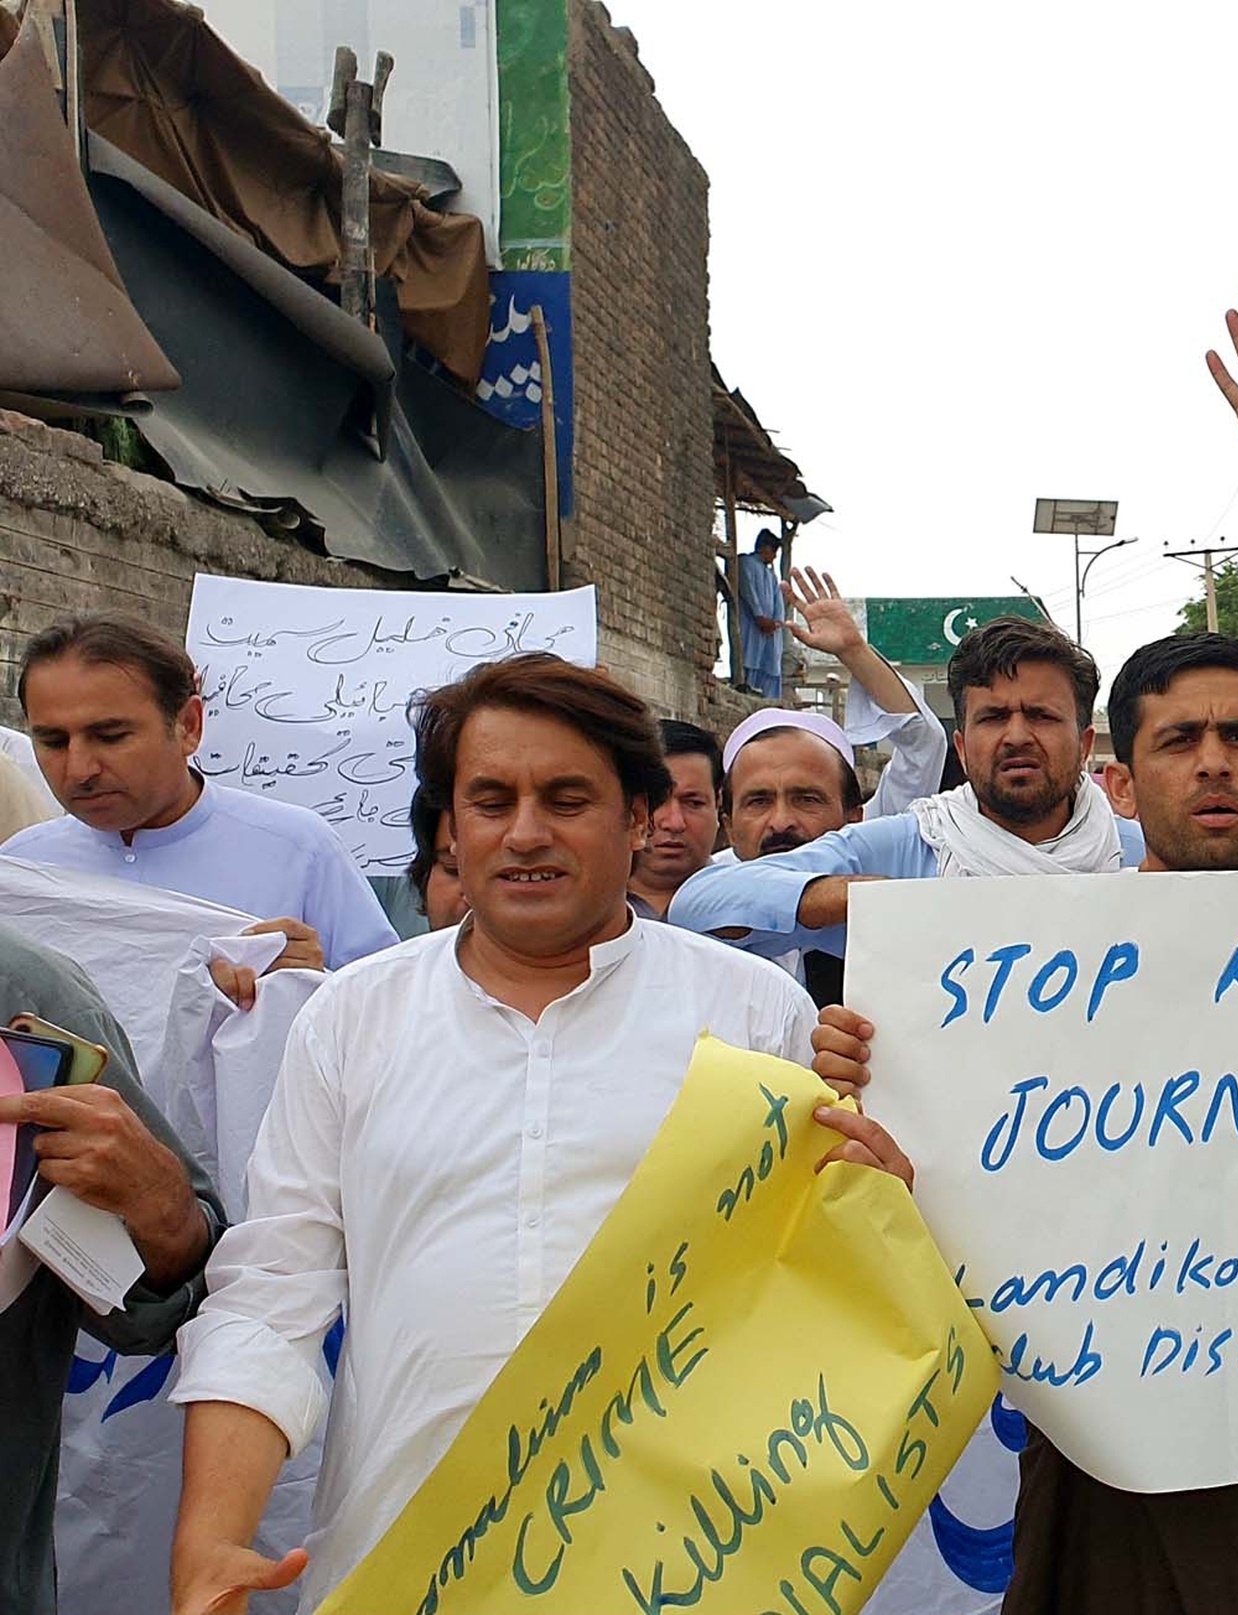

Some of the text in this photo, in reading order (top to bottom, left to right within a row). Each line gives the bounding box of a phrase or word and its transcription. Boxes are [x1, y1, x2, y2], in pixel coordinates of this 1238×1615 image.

[939, 942, 1139, 1029] STOP
[716, 1081, 791, 1222] not
[511, 1302, 710, 1596] CRIME
